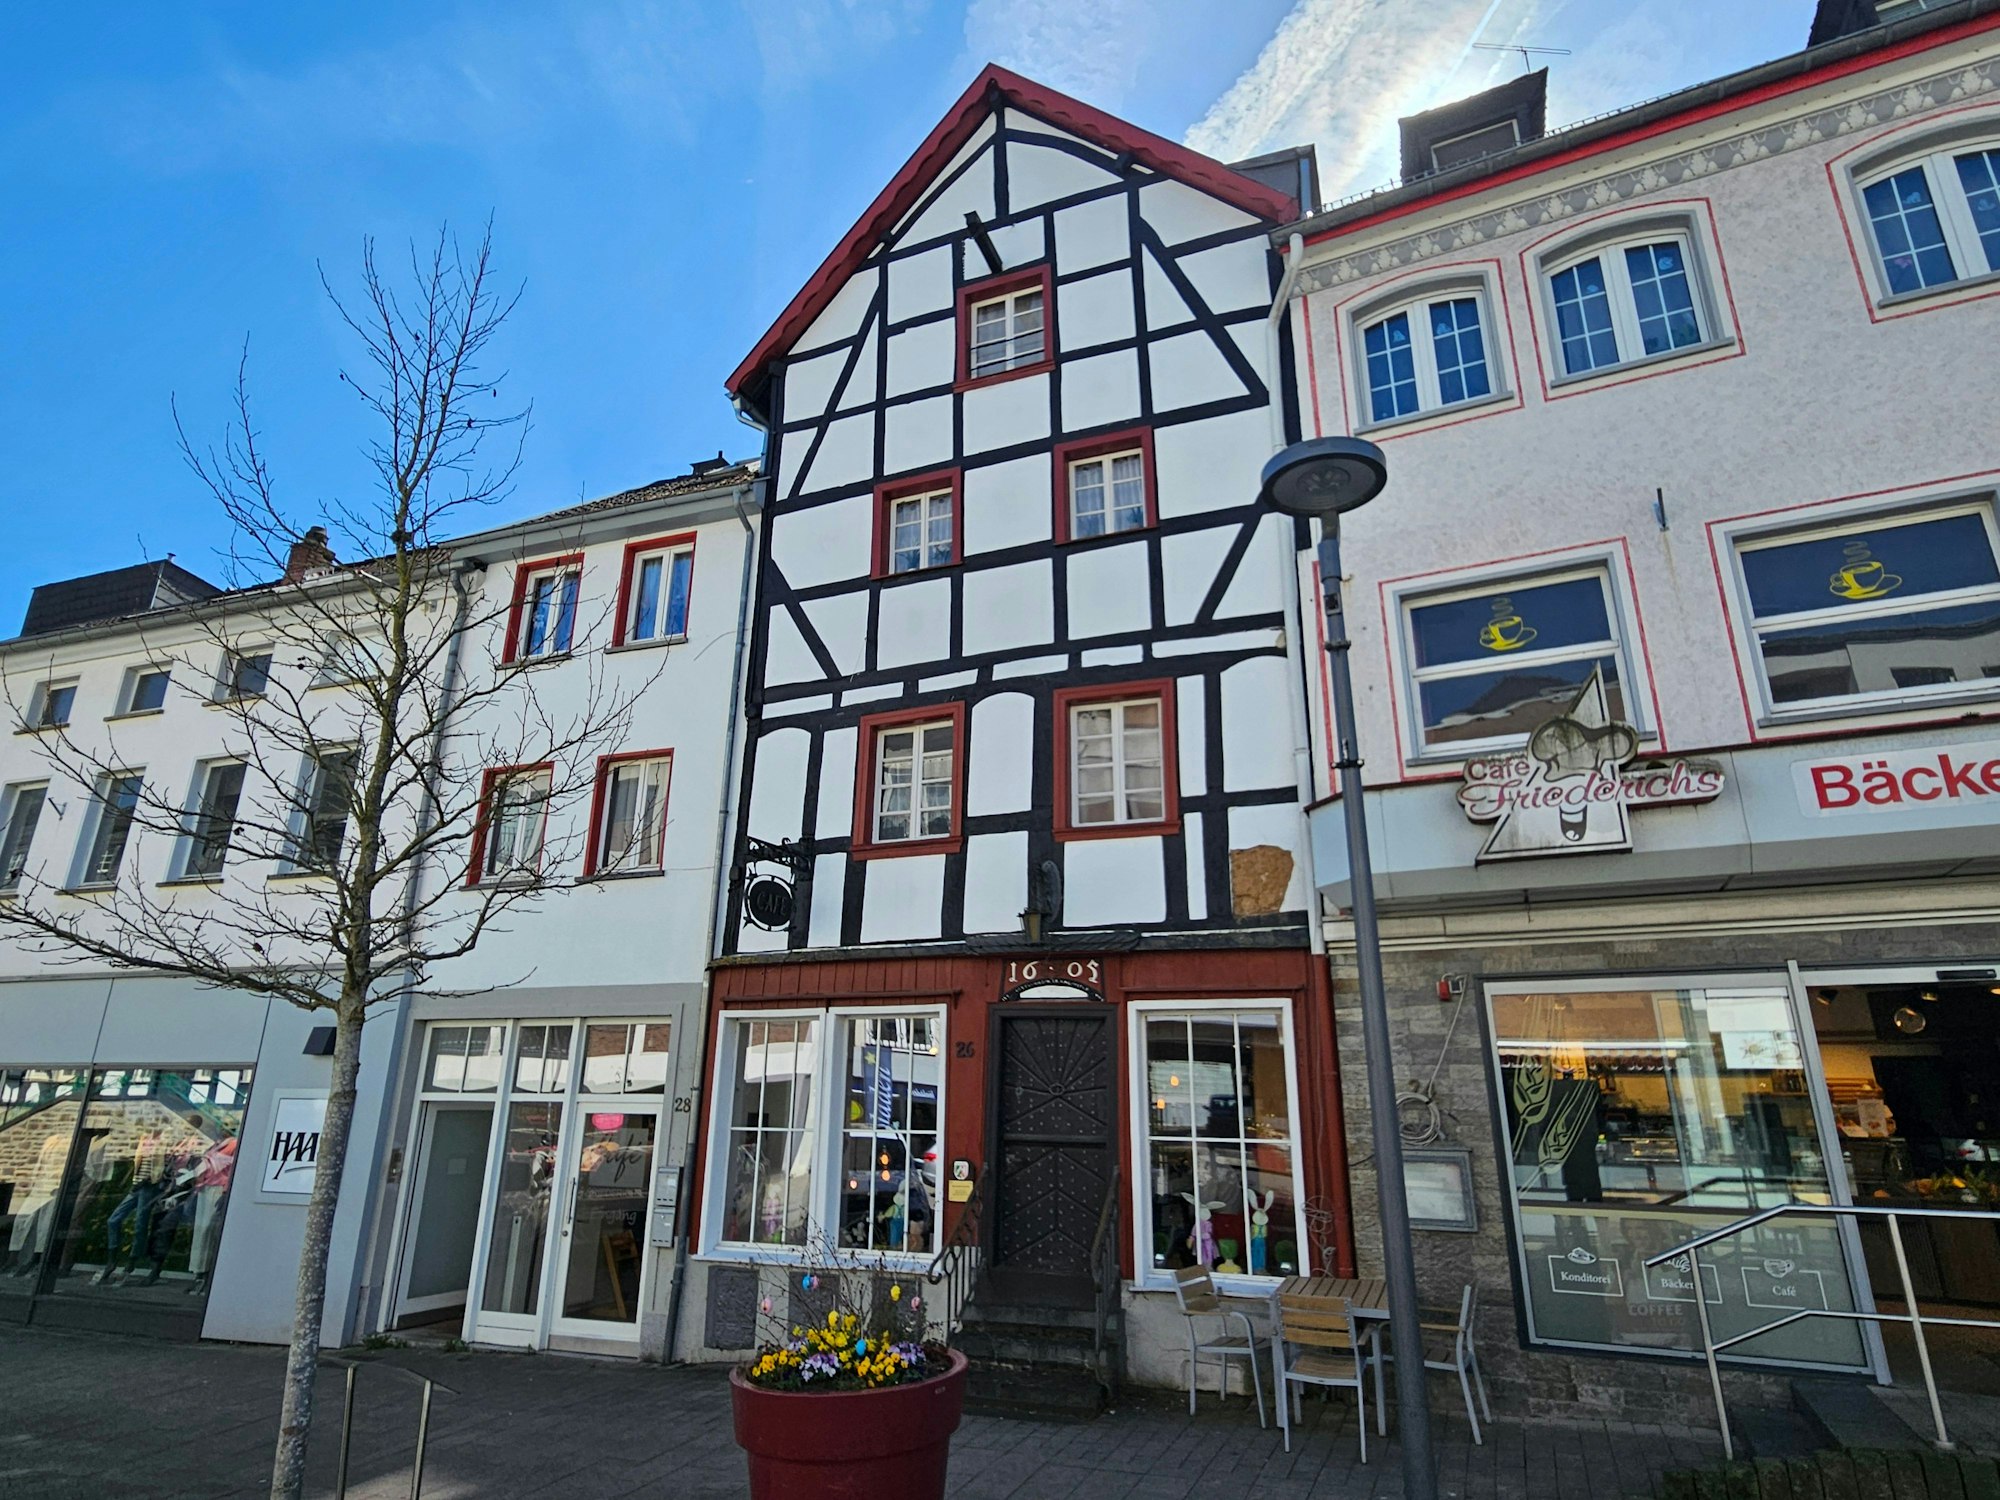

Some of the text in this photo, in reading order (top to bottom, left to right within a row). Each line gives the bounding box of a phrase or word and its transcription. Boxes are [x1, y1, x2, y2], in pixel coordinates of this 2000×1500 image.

[1460, 762, 1722, 816] Friederichs
[1810, 753, 2000, 809] Bäcke
[955, 1041, 976, 1058] 26
[674, 1097, 692, 1113] 28
[1560, 1271, 1611, 1285] Konditorei
[1772, 1284, 1797, 1297] Café
[1628, 1304, 1683, 1316] COFFEE
